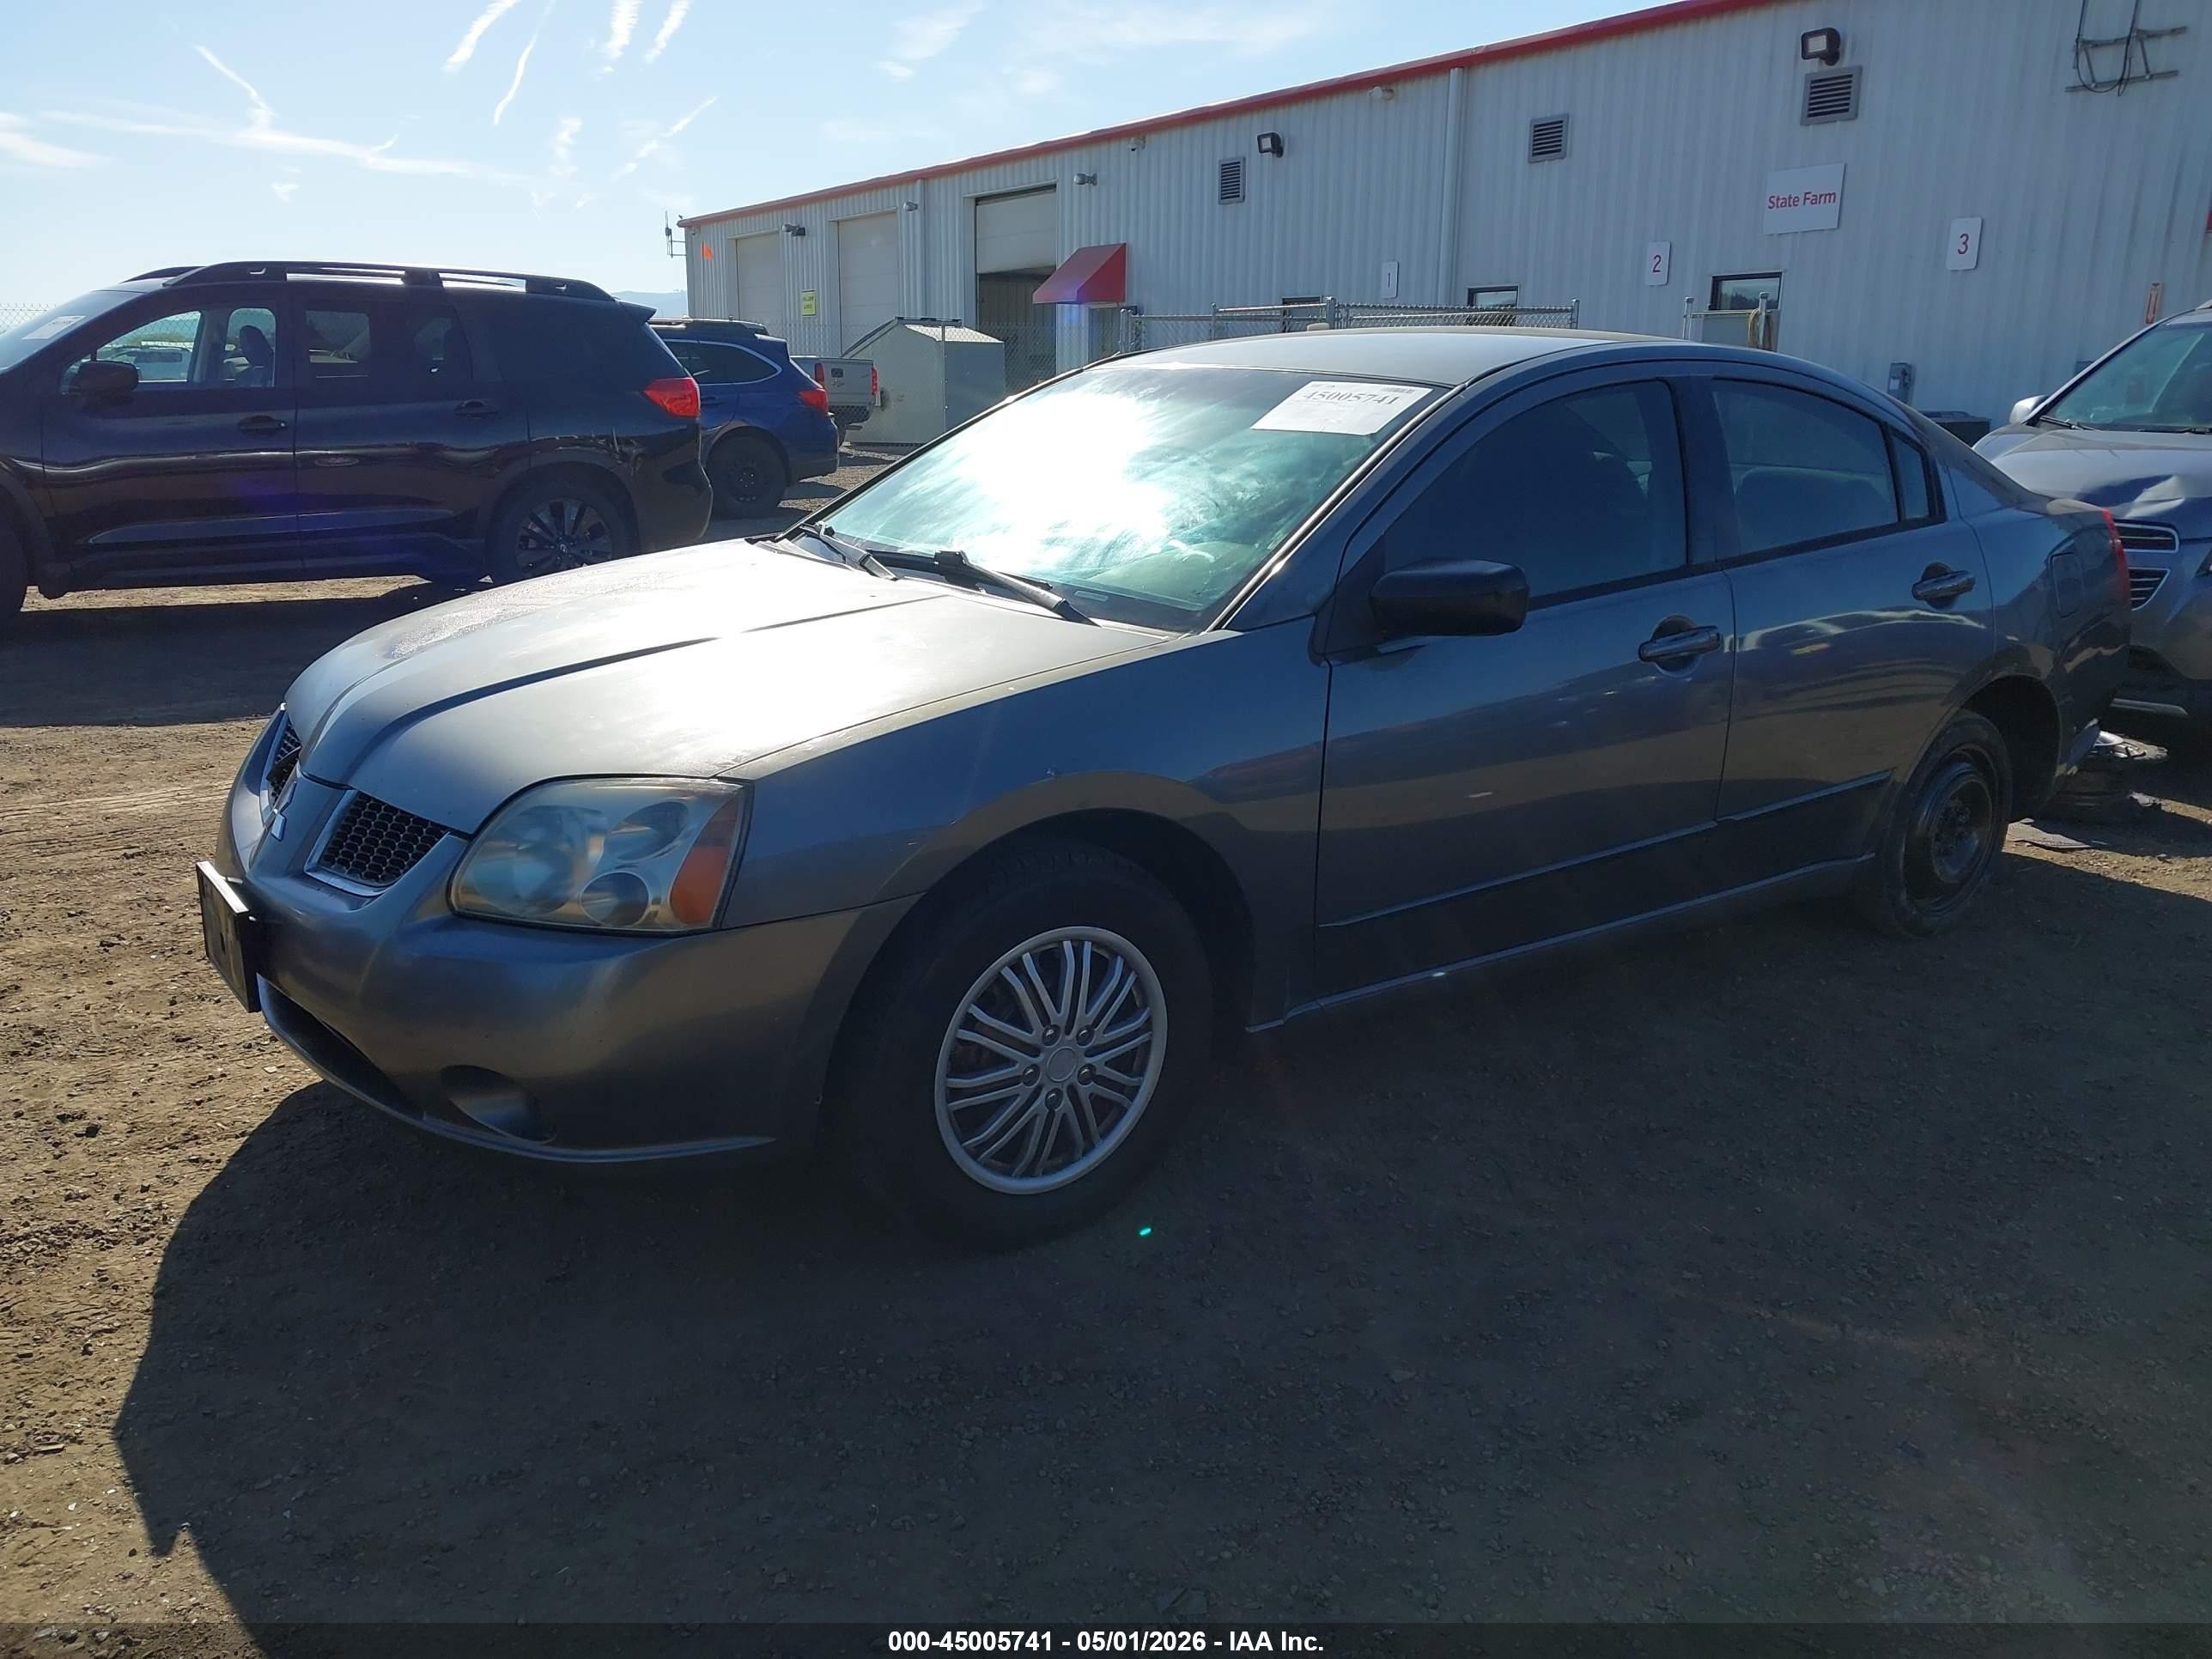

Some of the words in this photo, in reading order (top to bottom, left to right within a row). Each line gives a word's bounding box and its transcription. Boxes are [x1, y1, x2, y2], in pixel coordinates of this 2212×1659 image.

[1768, 194, 1800, 210] State
[1803, 191, 1837, 206] Farm
[1958, 233, 1969, 255] 3
[1653, 254, 1662, 273] 2
[1303, 391, 1401, 405] 45005741
